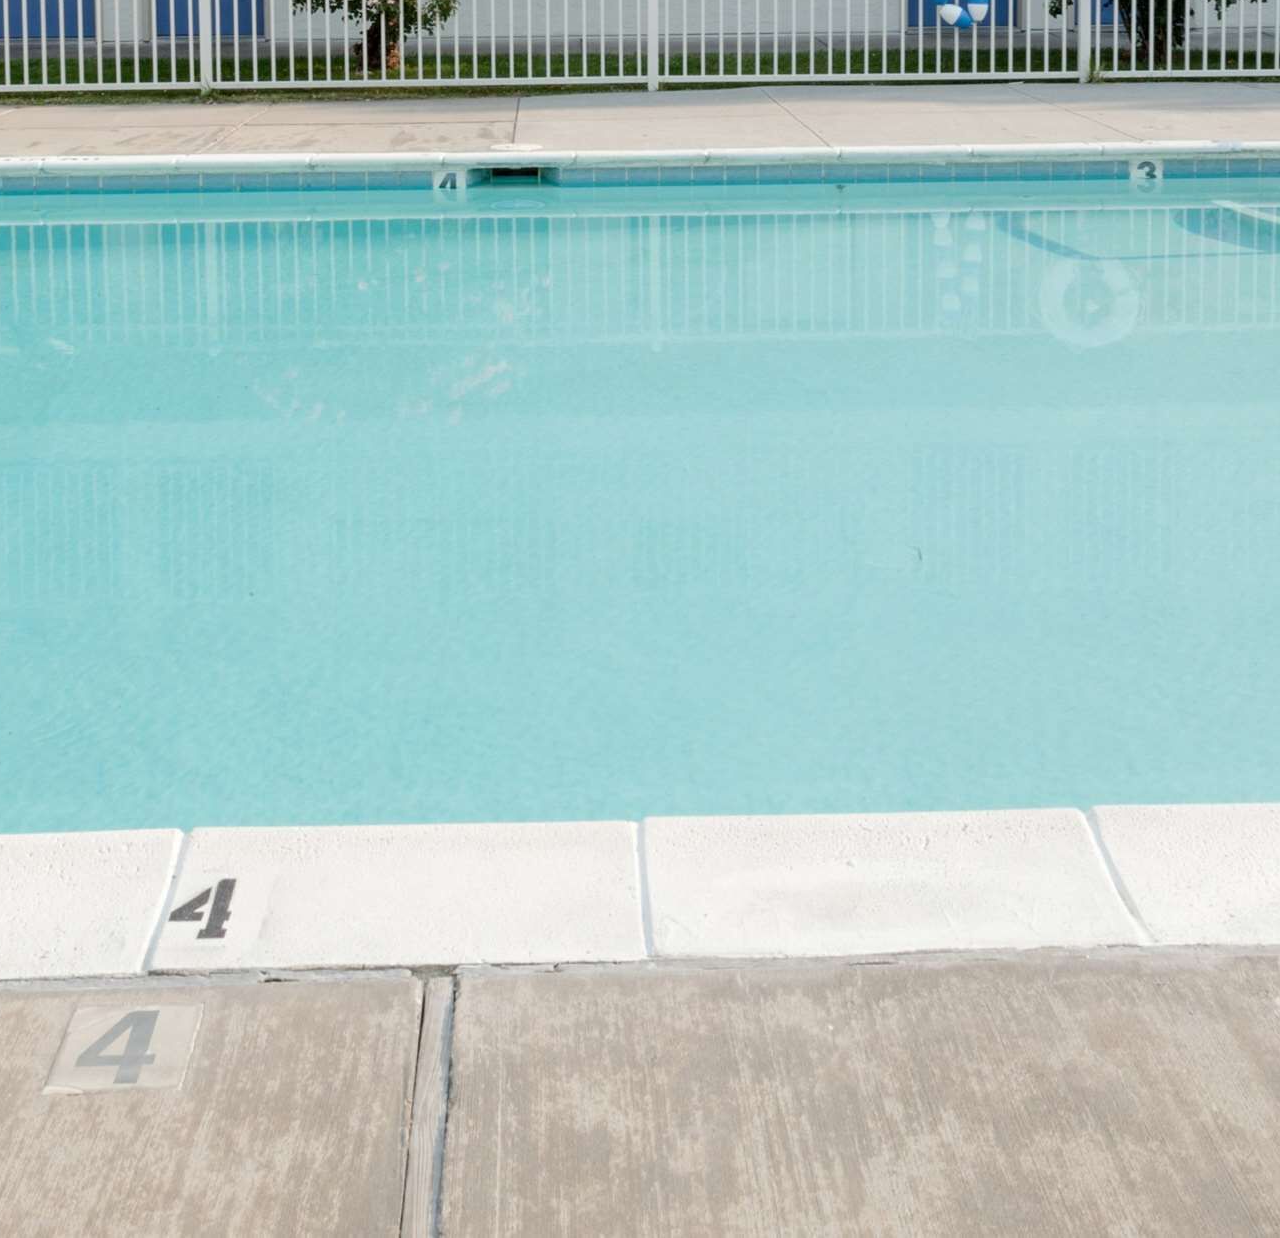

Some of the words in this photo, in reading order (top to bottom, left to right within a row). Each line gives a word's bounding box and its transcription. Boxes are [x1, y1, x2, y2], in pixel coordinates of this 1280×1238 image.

[1136, 160, 1157, 180] 3
[167, 878, 237, 940] 4
[74, 1009, 161, 1085] 4
